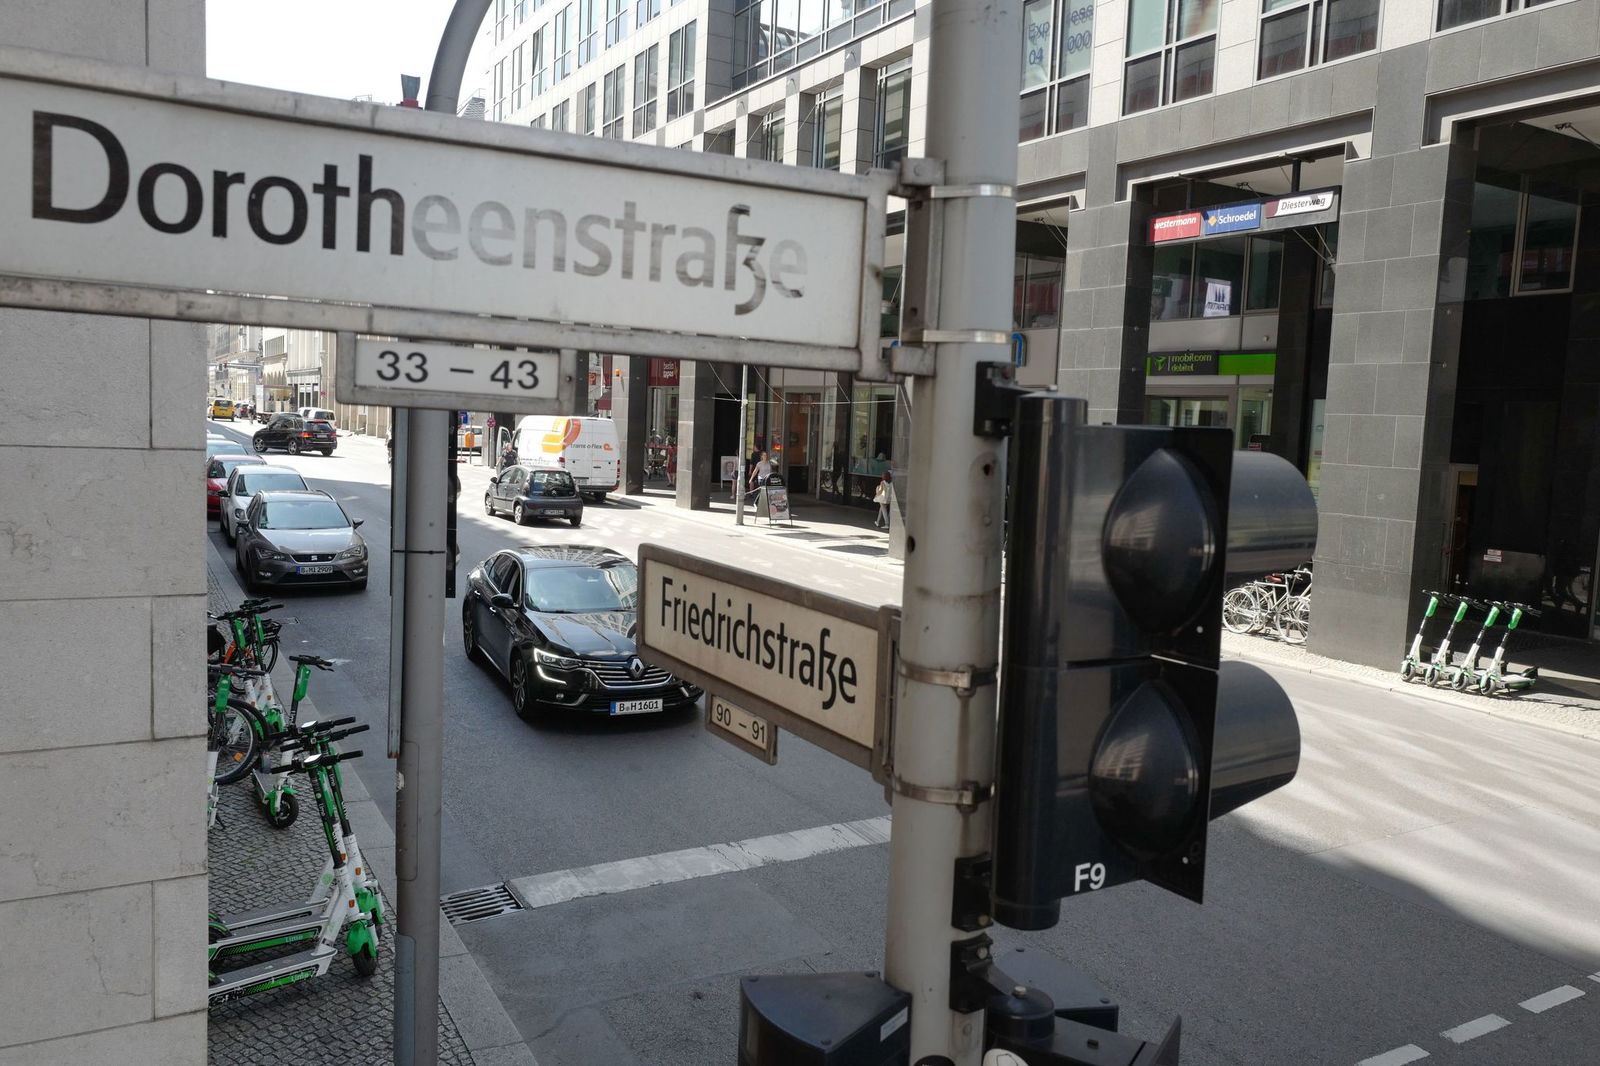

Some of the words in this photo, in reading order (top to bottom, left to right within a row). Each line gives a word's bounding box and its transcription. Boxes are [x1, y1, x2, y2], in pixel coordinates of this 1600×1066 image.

[32, 110, 808, 316] Dorotheenstraße
[1218, 209, 1257, 225] Schroedel
[1281, 197, 1326, 211] Diesterweg
[1154, 216, 1197, 229] westermann
[376, 350, 429, 384] 33
[489, 359, 540, 390] 43
[661, 576, 858, 710] Friedrichstraße
[716, 703, 732, 727] 90
[751, 720, 765, 744] 91
[1074, 862, 1106, 892] F9
